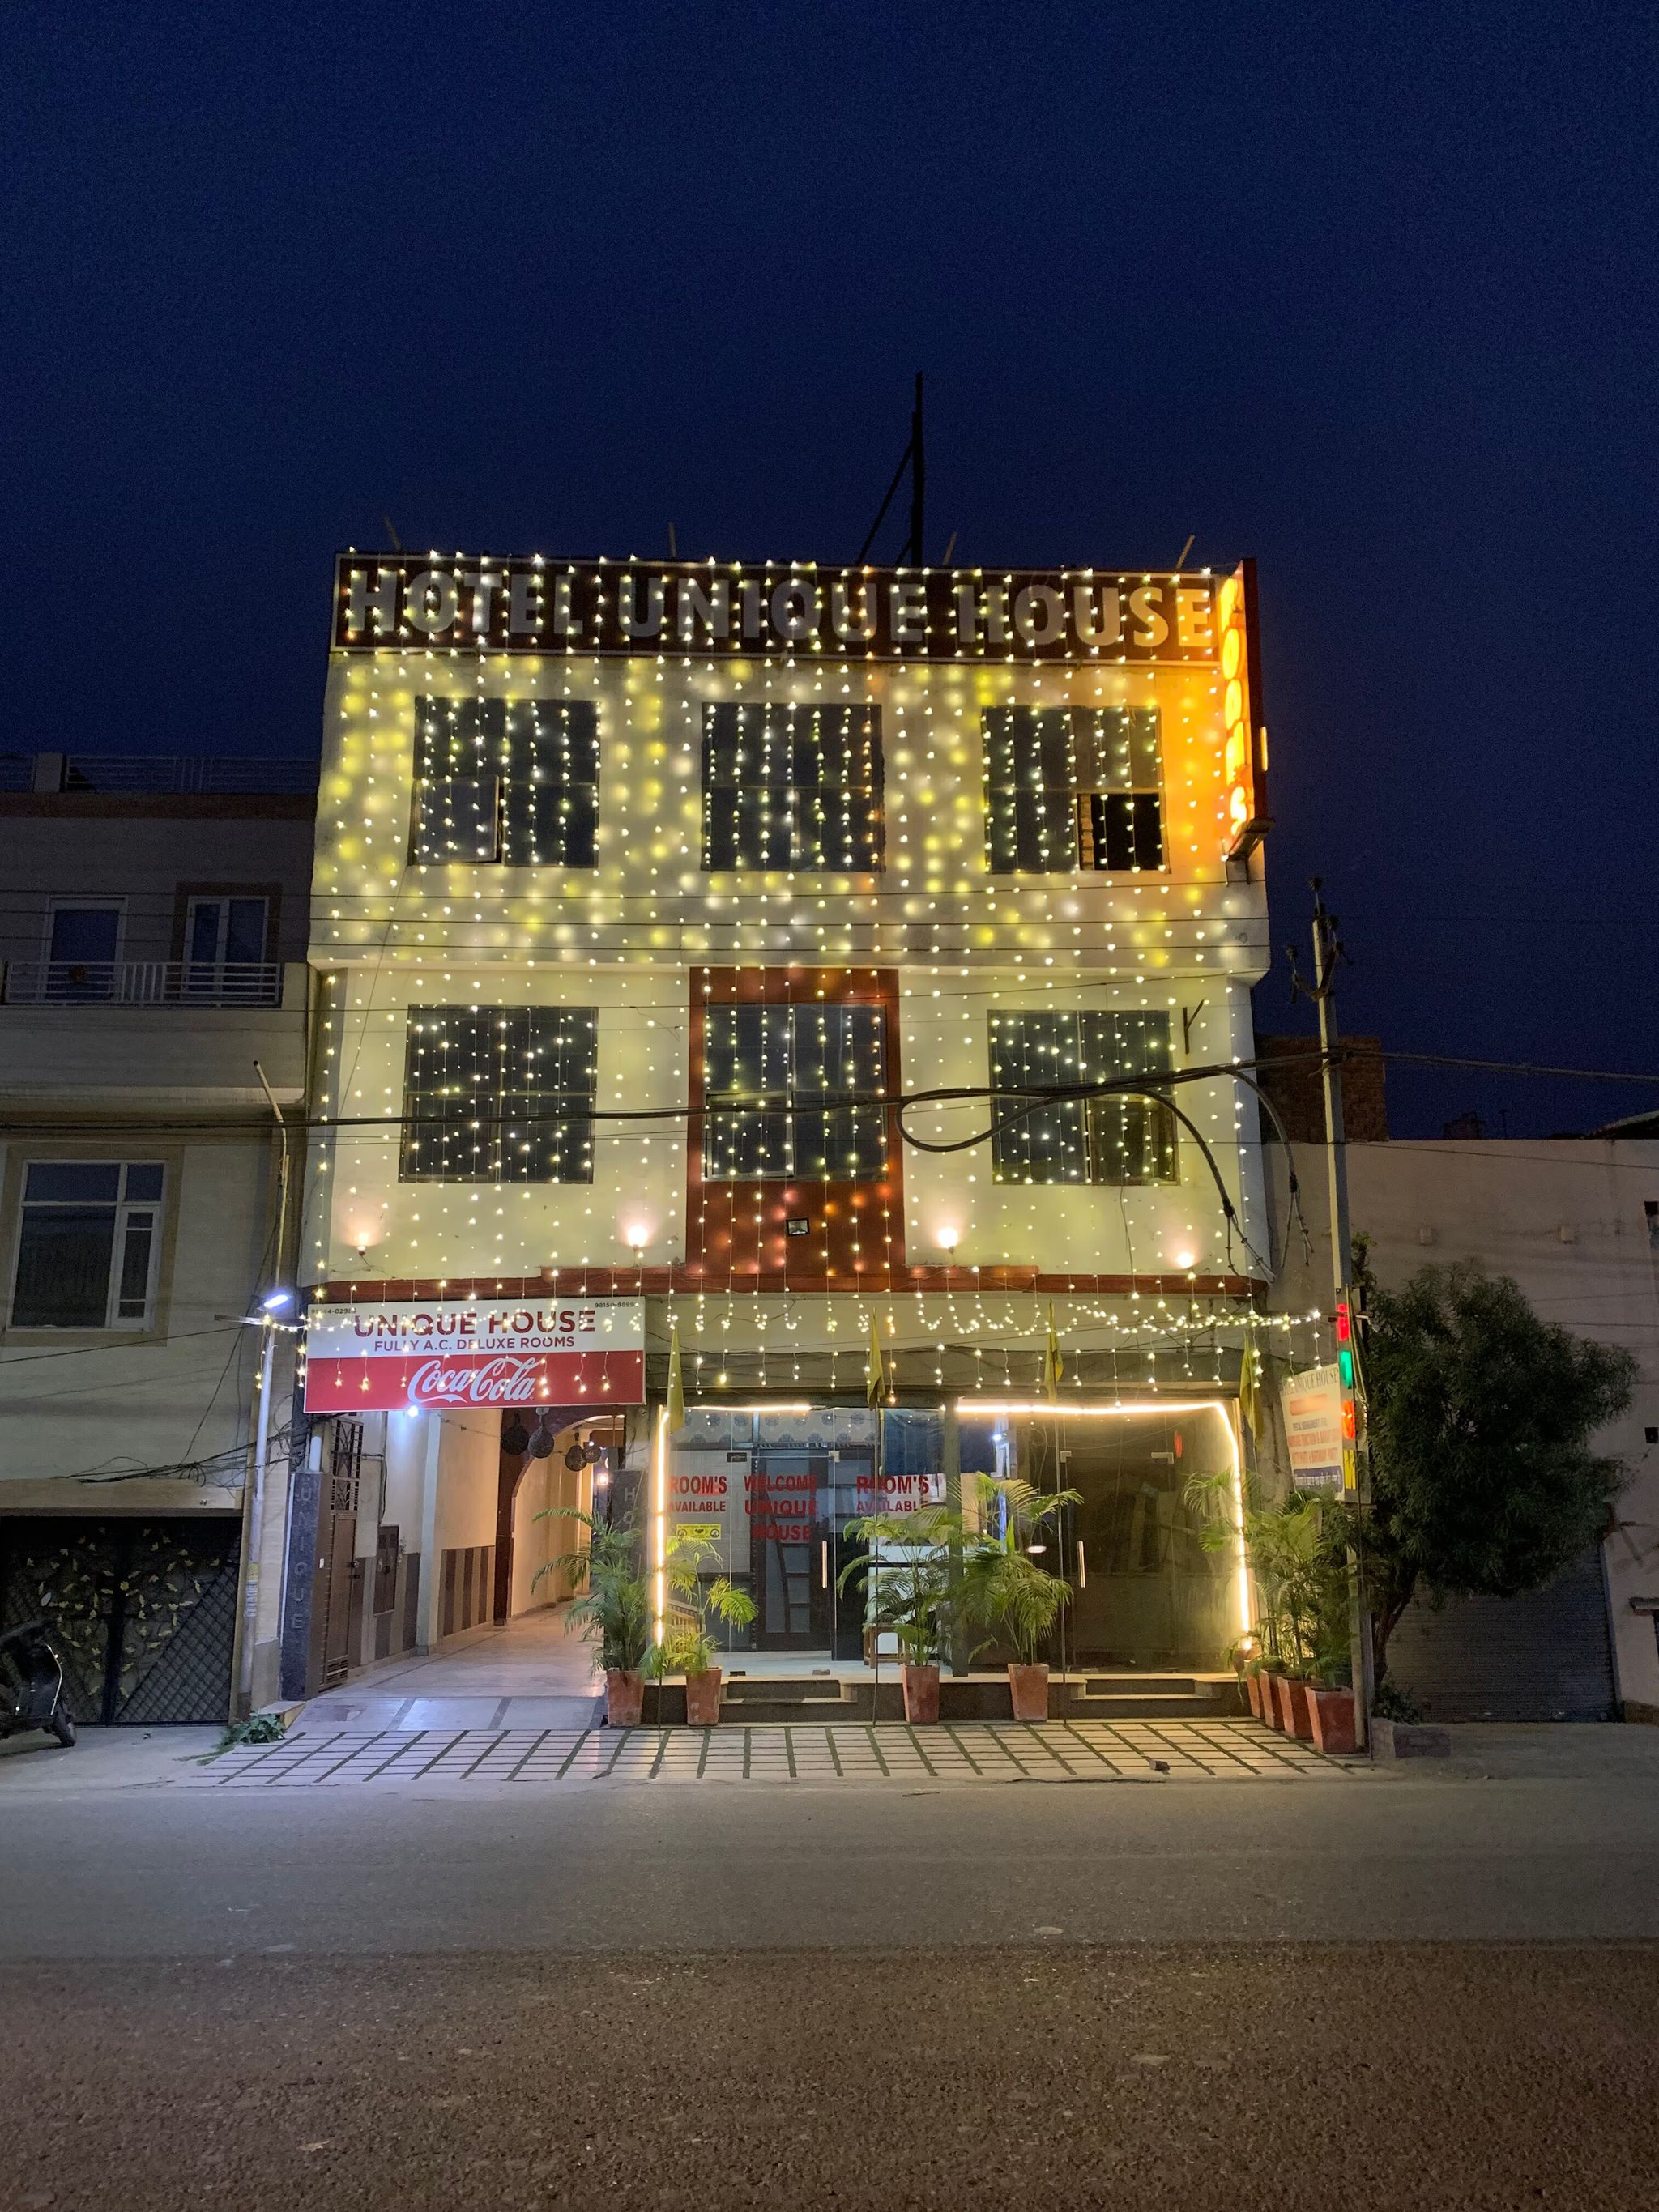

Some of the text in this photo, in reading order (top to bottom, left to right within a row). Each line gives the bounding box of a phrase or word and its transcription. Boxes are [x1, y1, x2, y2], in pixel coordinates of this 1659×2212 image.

[347, 569, 1212, 647] HOTEL UNIQUE HOUSE
[354, 1310, 595, 1337] UNIQUE HOUSE
[374, 1336, 574, 1351] FULLY A.C. DELUXE ROOMS
[669, 1475, 727, 1494] ROOM'S
[744, 1474, 817, 1492] WELCOME
[855, 1475, 929, 1494] ROOM'S
[670, 1500, 726, 1513] AVAILABLE
[744, 1499, 817, 1517] UNIQUE
[751, 1524, 812, 1541] HOUSE
